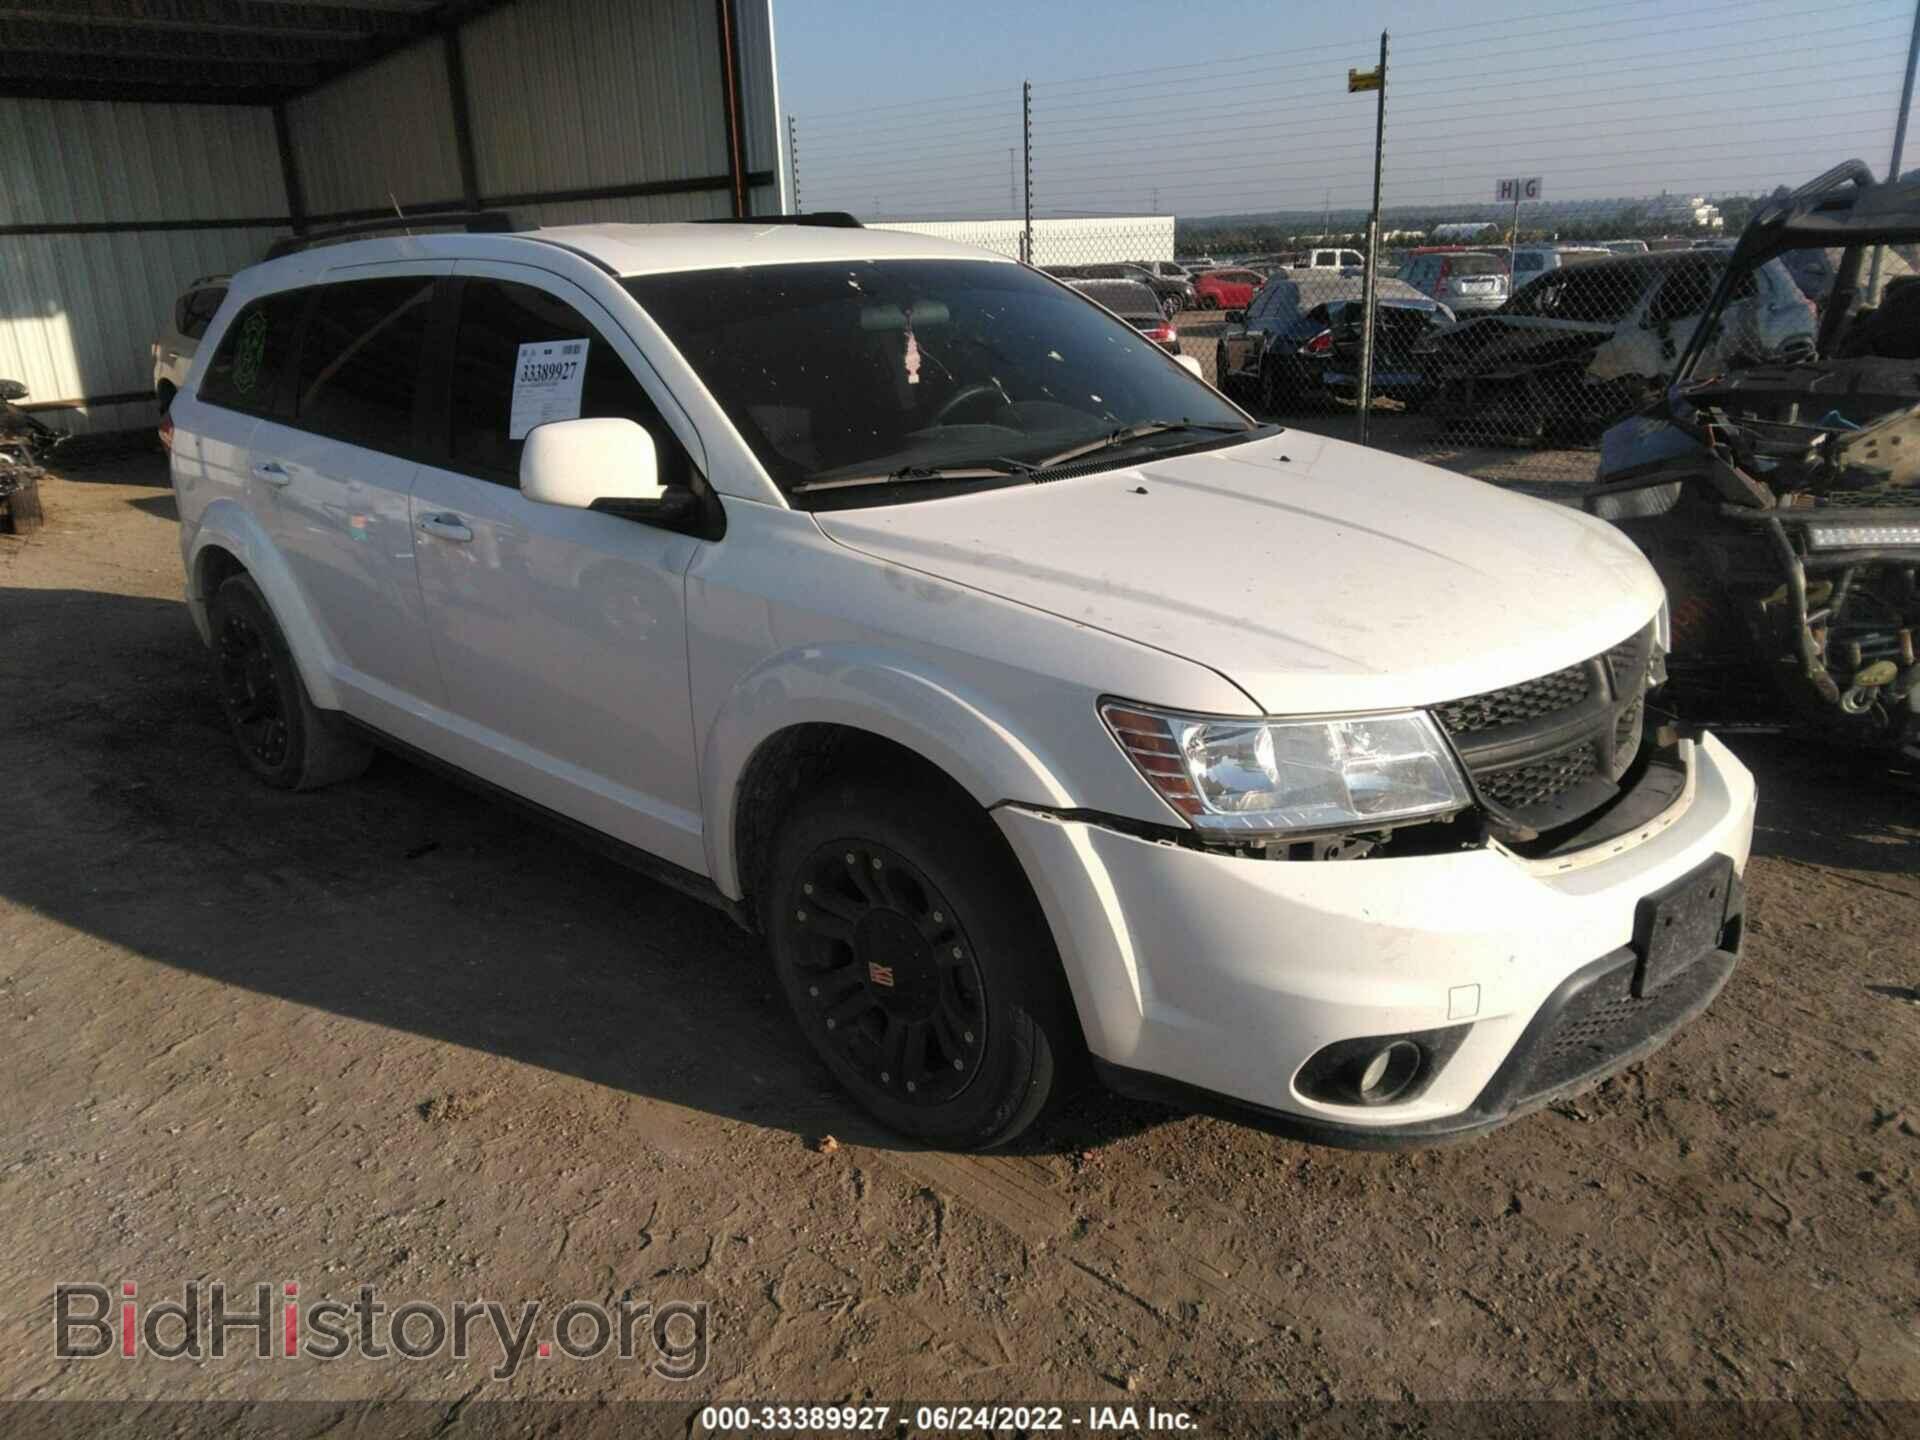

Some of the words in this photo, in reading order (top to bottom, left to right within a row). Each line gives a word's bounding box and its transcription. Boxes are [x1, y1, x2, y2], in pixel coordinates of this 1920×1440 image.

[1502, 182, 1512, 198] H
[1526, 180, 1536, 197] G
[520, 361, 577, 382] 33389927
